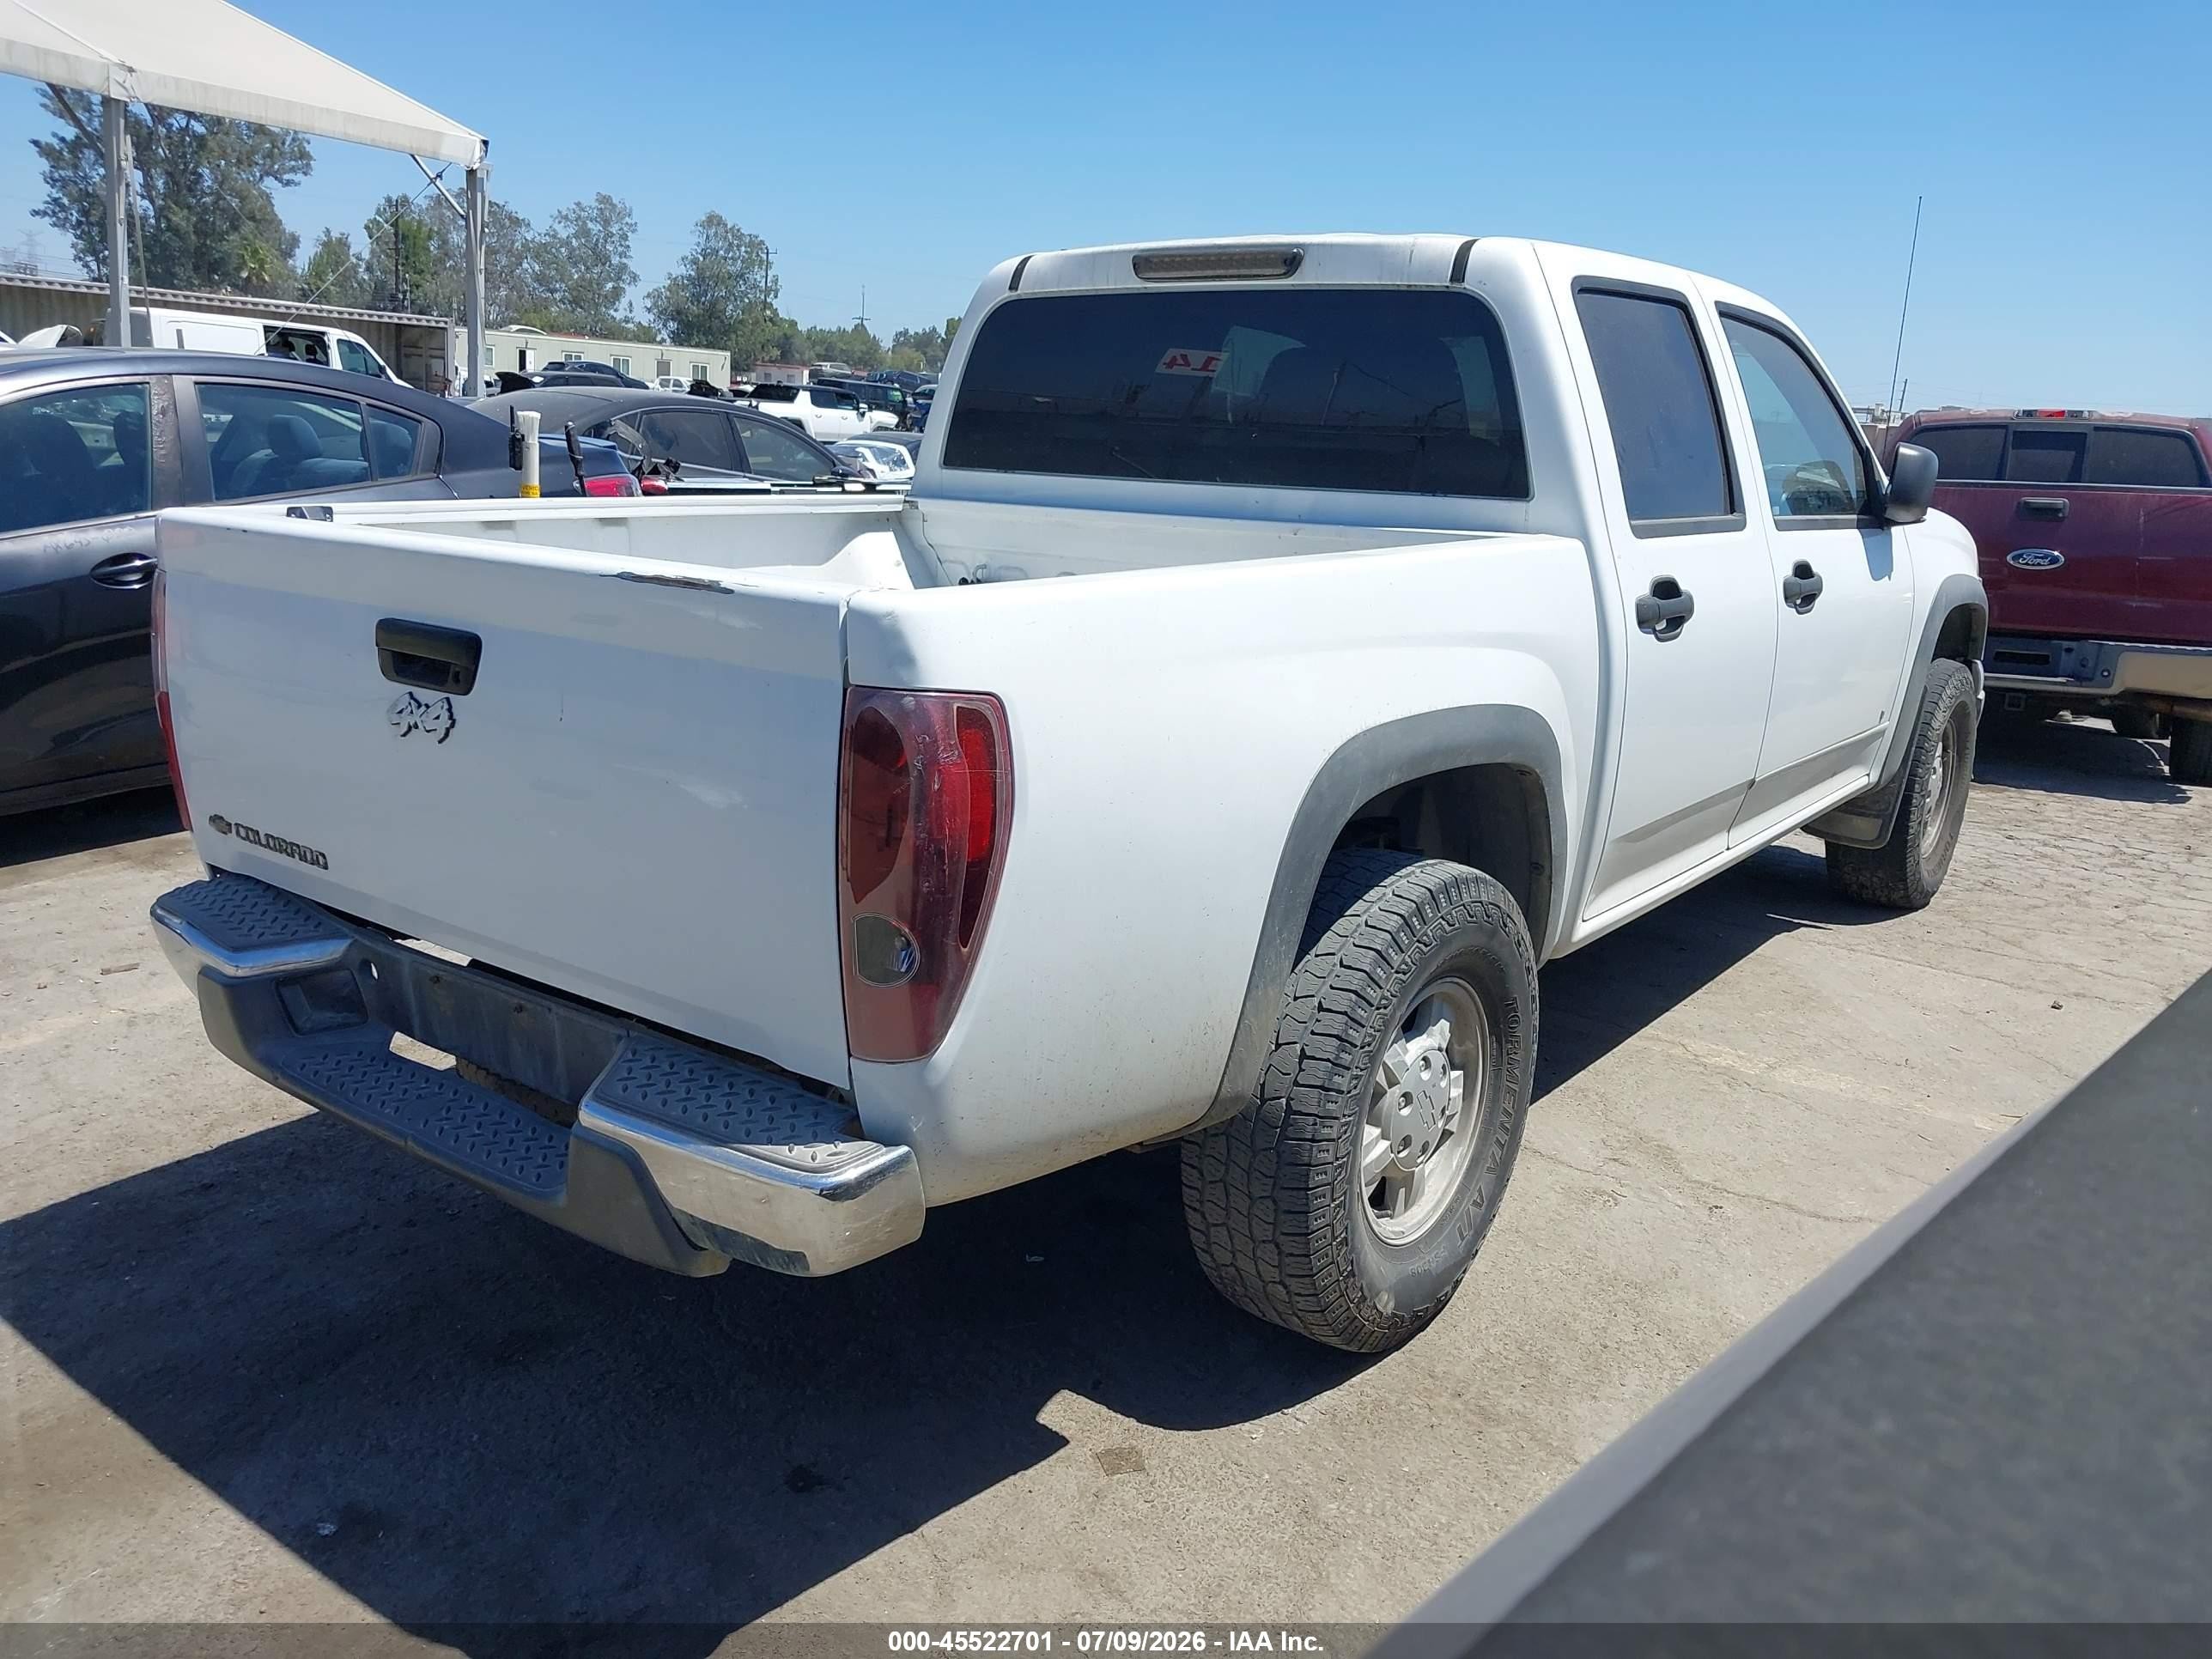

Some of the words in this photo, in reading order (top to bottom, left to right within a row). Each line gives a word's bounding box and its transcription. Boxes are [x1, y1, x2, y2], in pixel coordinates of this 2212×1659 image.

[2020, 552, 2051, 565] Ford
[386, 691, 457, 744] 4x4
[234, 822, 330, 871] COLORADO
[1485, 995, 1523, 1176] TORMENTA
[1456, 1185, 1486, 1248] A/T
